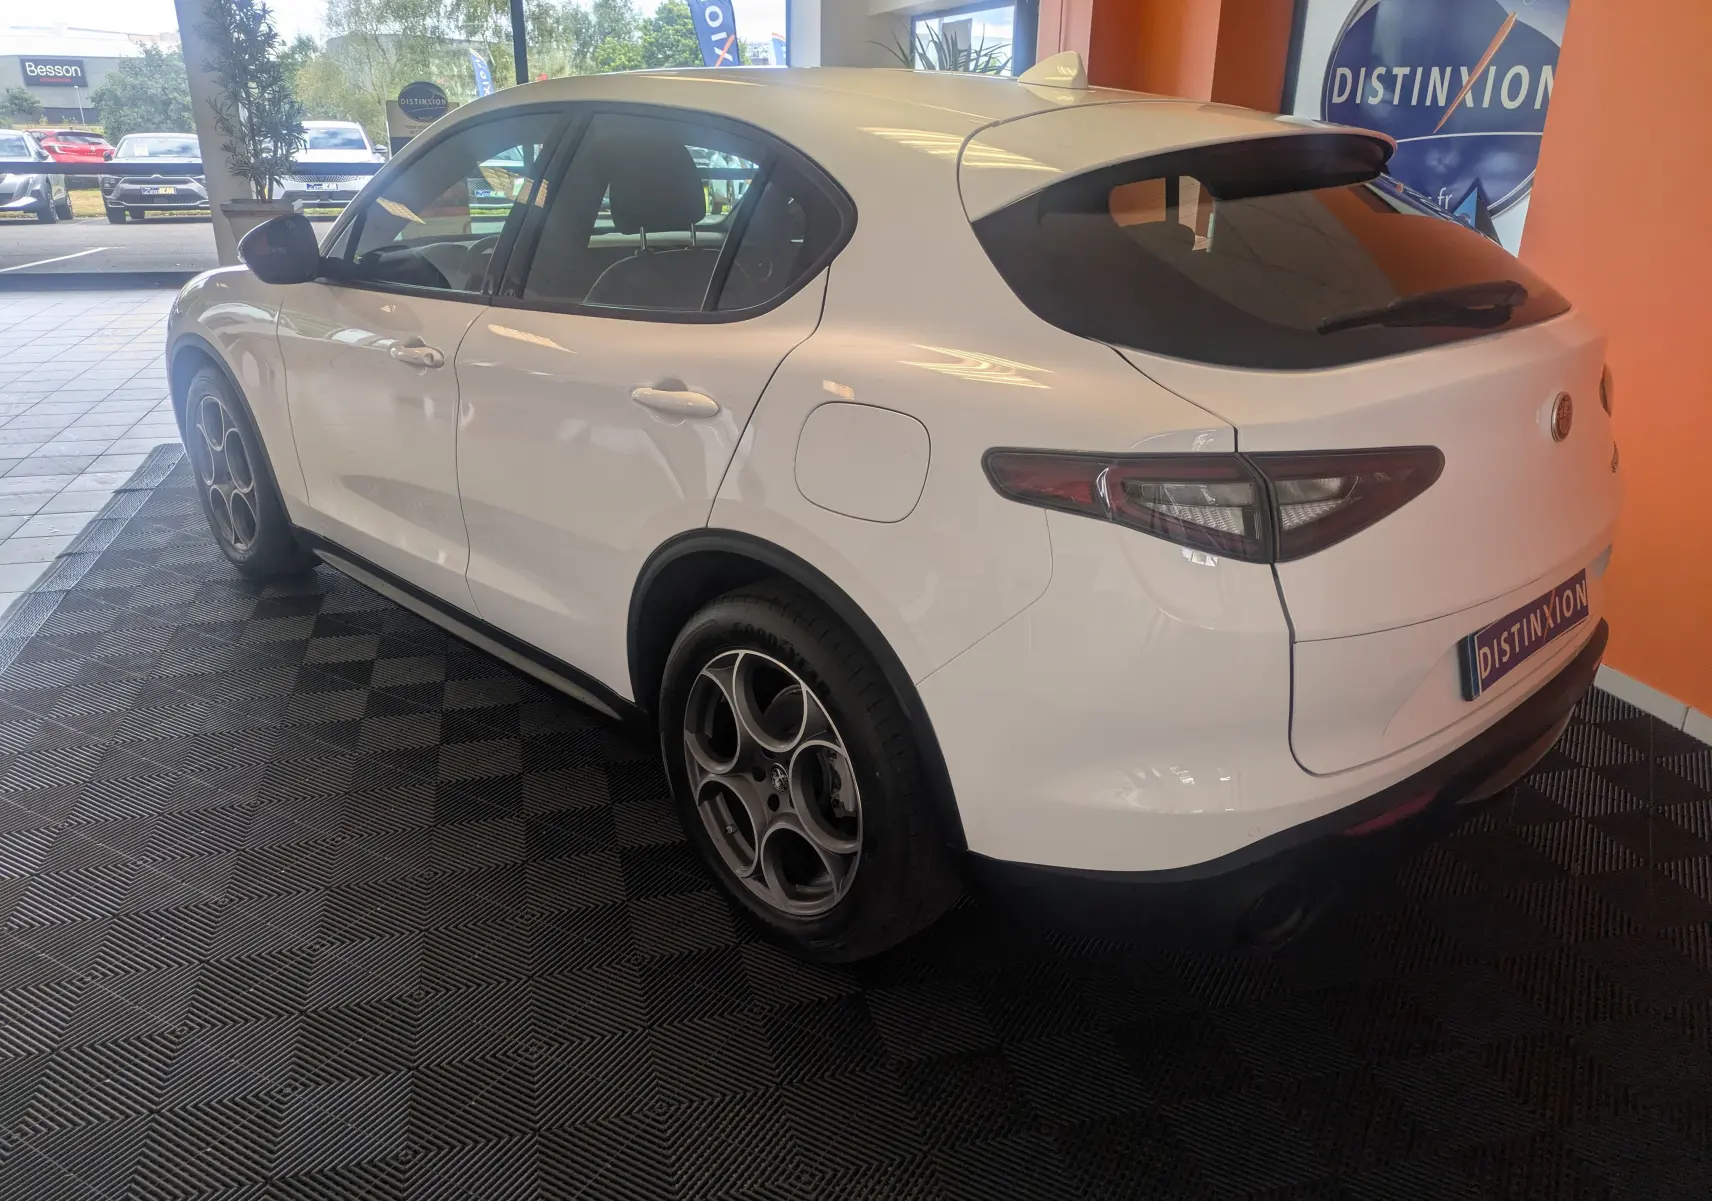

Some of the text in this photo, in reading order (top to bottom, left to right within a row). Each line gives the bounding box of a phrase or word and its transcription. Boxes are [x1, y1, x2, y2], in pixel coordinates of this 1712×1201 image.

[25, 62, 81, 77] Besson
[400, 98, 447, 106] DISTINXION
[1479, 579, 1587, 680] DISTINXION
